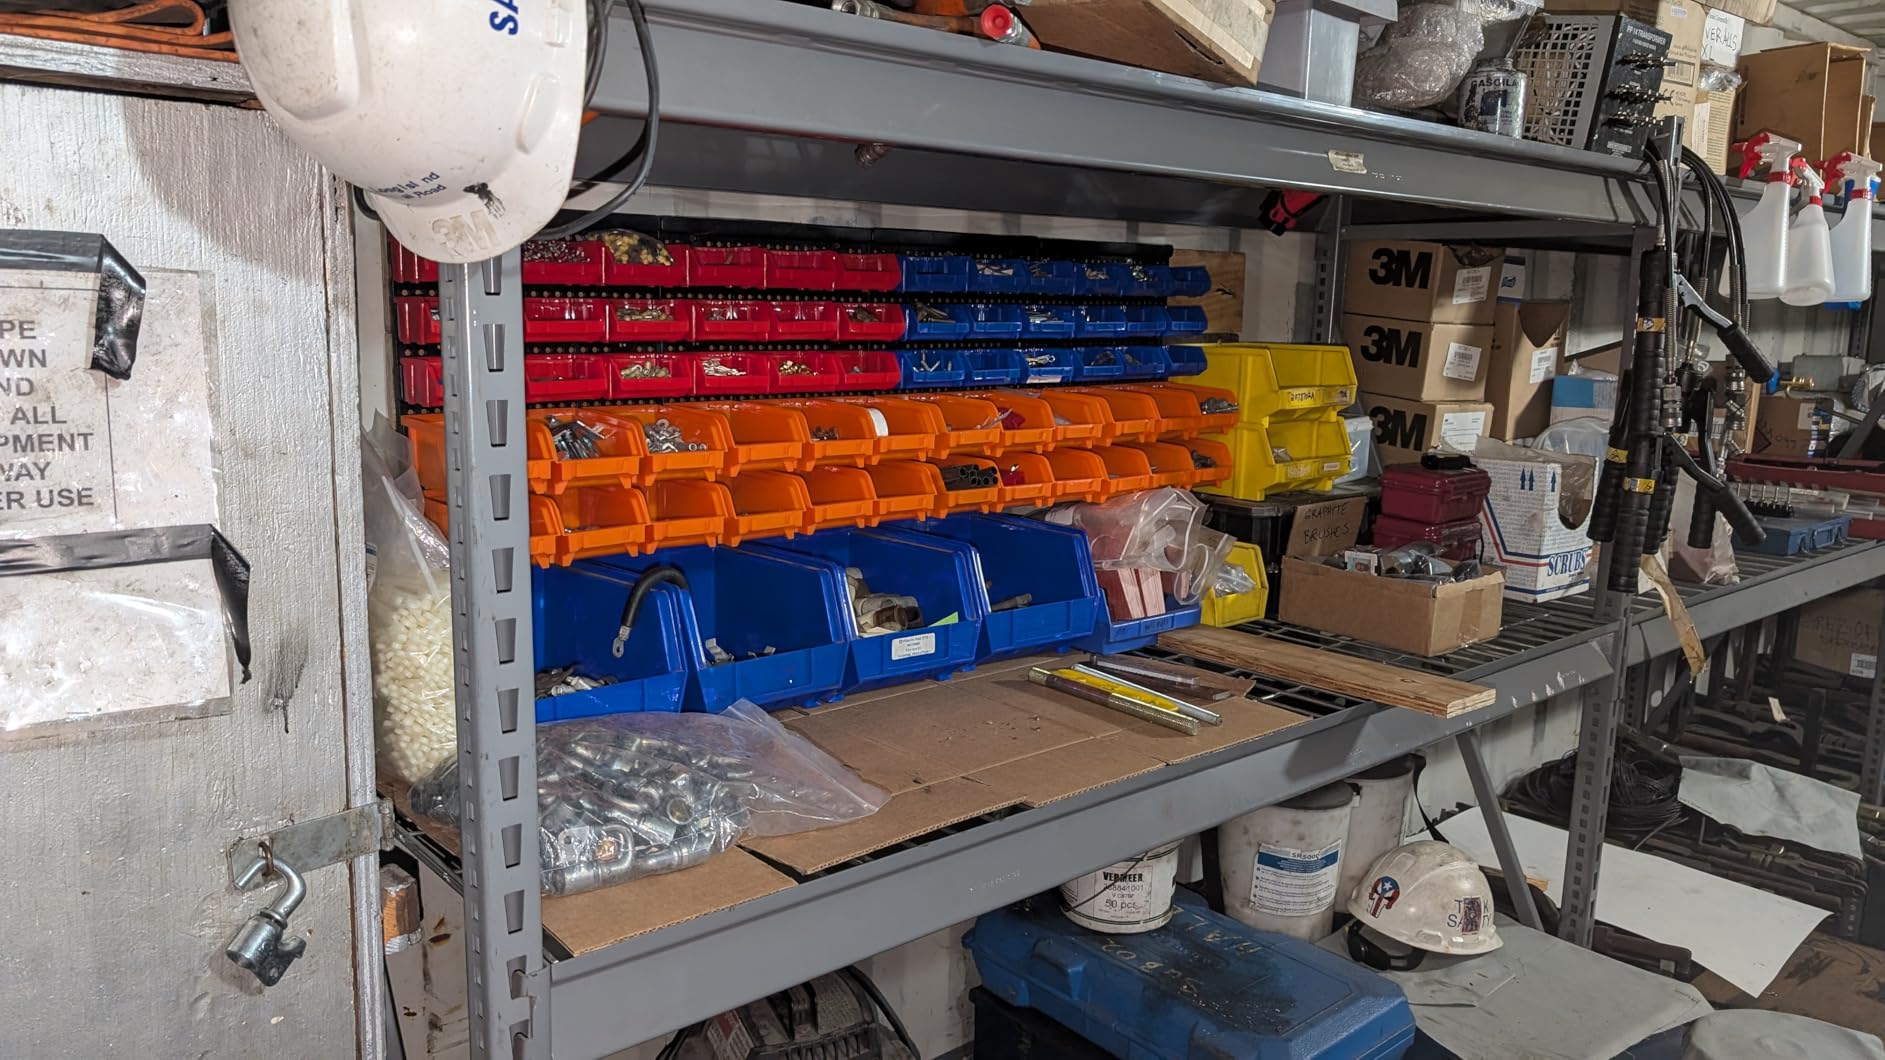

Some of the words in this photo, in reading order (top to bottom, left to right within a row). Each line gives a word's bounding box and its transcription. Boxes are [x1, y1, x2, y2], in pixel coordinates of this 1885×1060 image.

[1368, 247, 1433, 289] 3M
[1360, 325, 1422, 368] 3M
[10, 405, 67, 425] ALL
[1368, 405, 1428, 452] 3M
[37, 487, 94, 508] USE
[1304, 501, 1350, 520] GRAPHITE
[1304, 522, 1350, 545] BRUSHES
[1547, 548, 1588, 577] SCRUBS
[1104, 898, 1118, 909] 50
